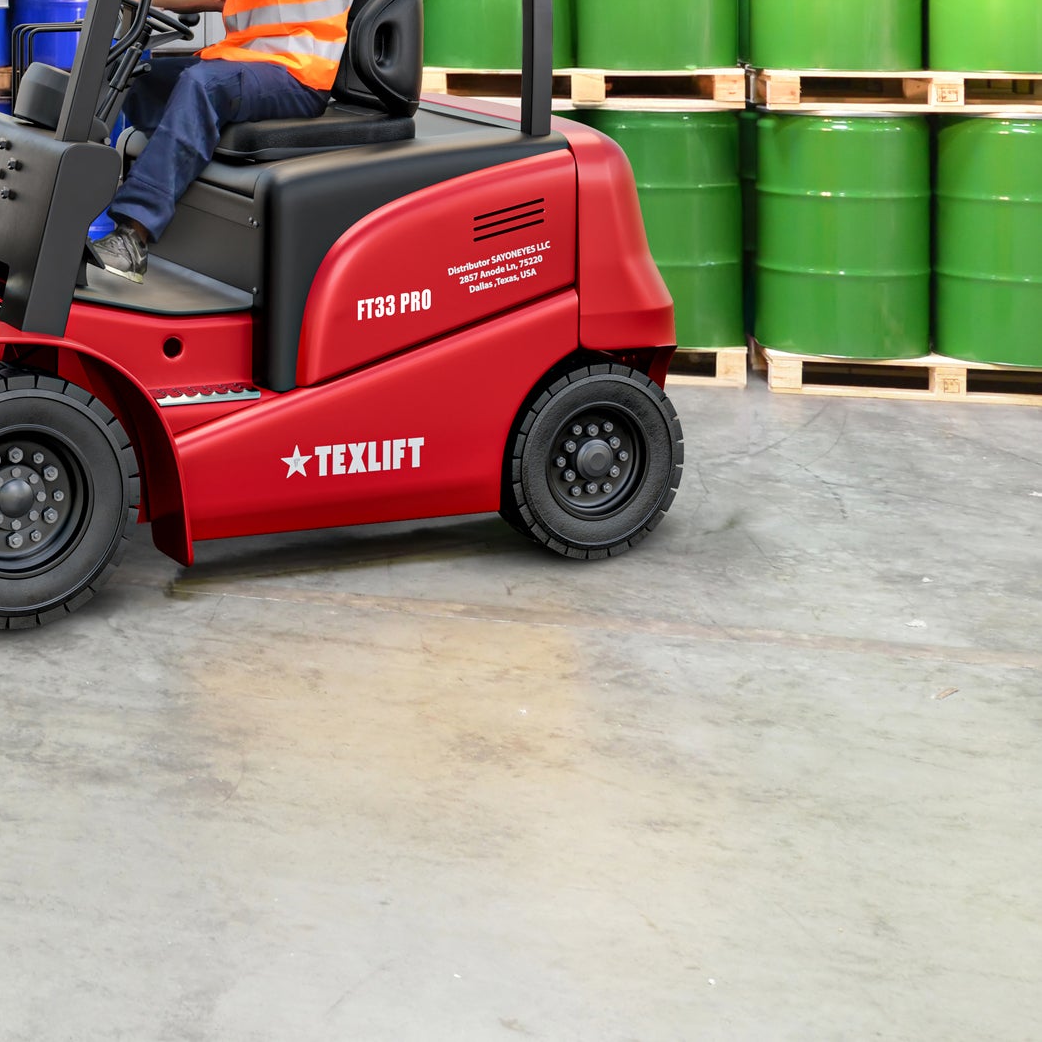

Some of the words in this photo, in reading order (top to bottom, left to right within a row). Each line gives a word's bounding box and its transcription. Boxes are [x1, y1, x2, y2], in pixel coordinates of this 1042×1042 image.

[447, 258, 491, 276] Distributor
[491, 244, 536, 264] SAYONEYES
[536, 240, 551, 252] LLC
[459, 272, 479, 285] 2857
[480, 265, 506, 279] Anode
[506, 263, 519, 272] Ln,
[519, 254, 543, 268] 75220
[469, 281, 494, 294] Dallas
[520, 267, 537, 279] USA
[357, 294, 396, 321] FT33
[400, 288, 432, 314] PRO
[314, 436, 425, 477] TEXLIFT
